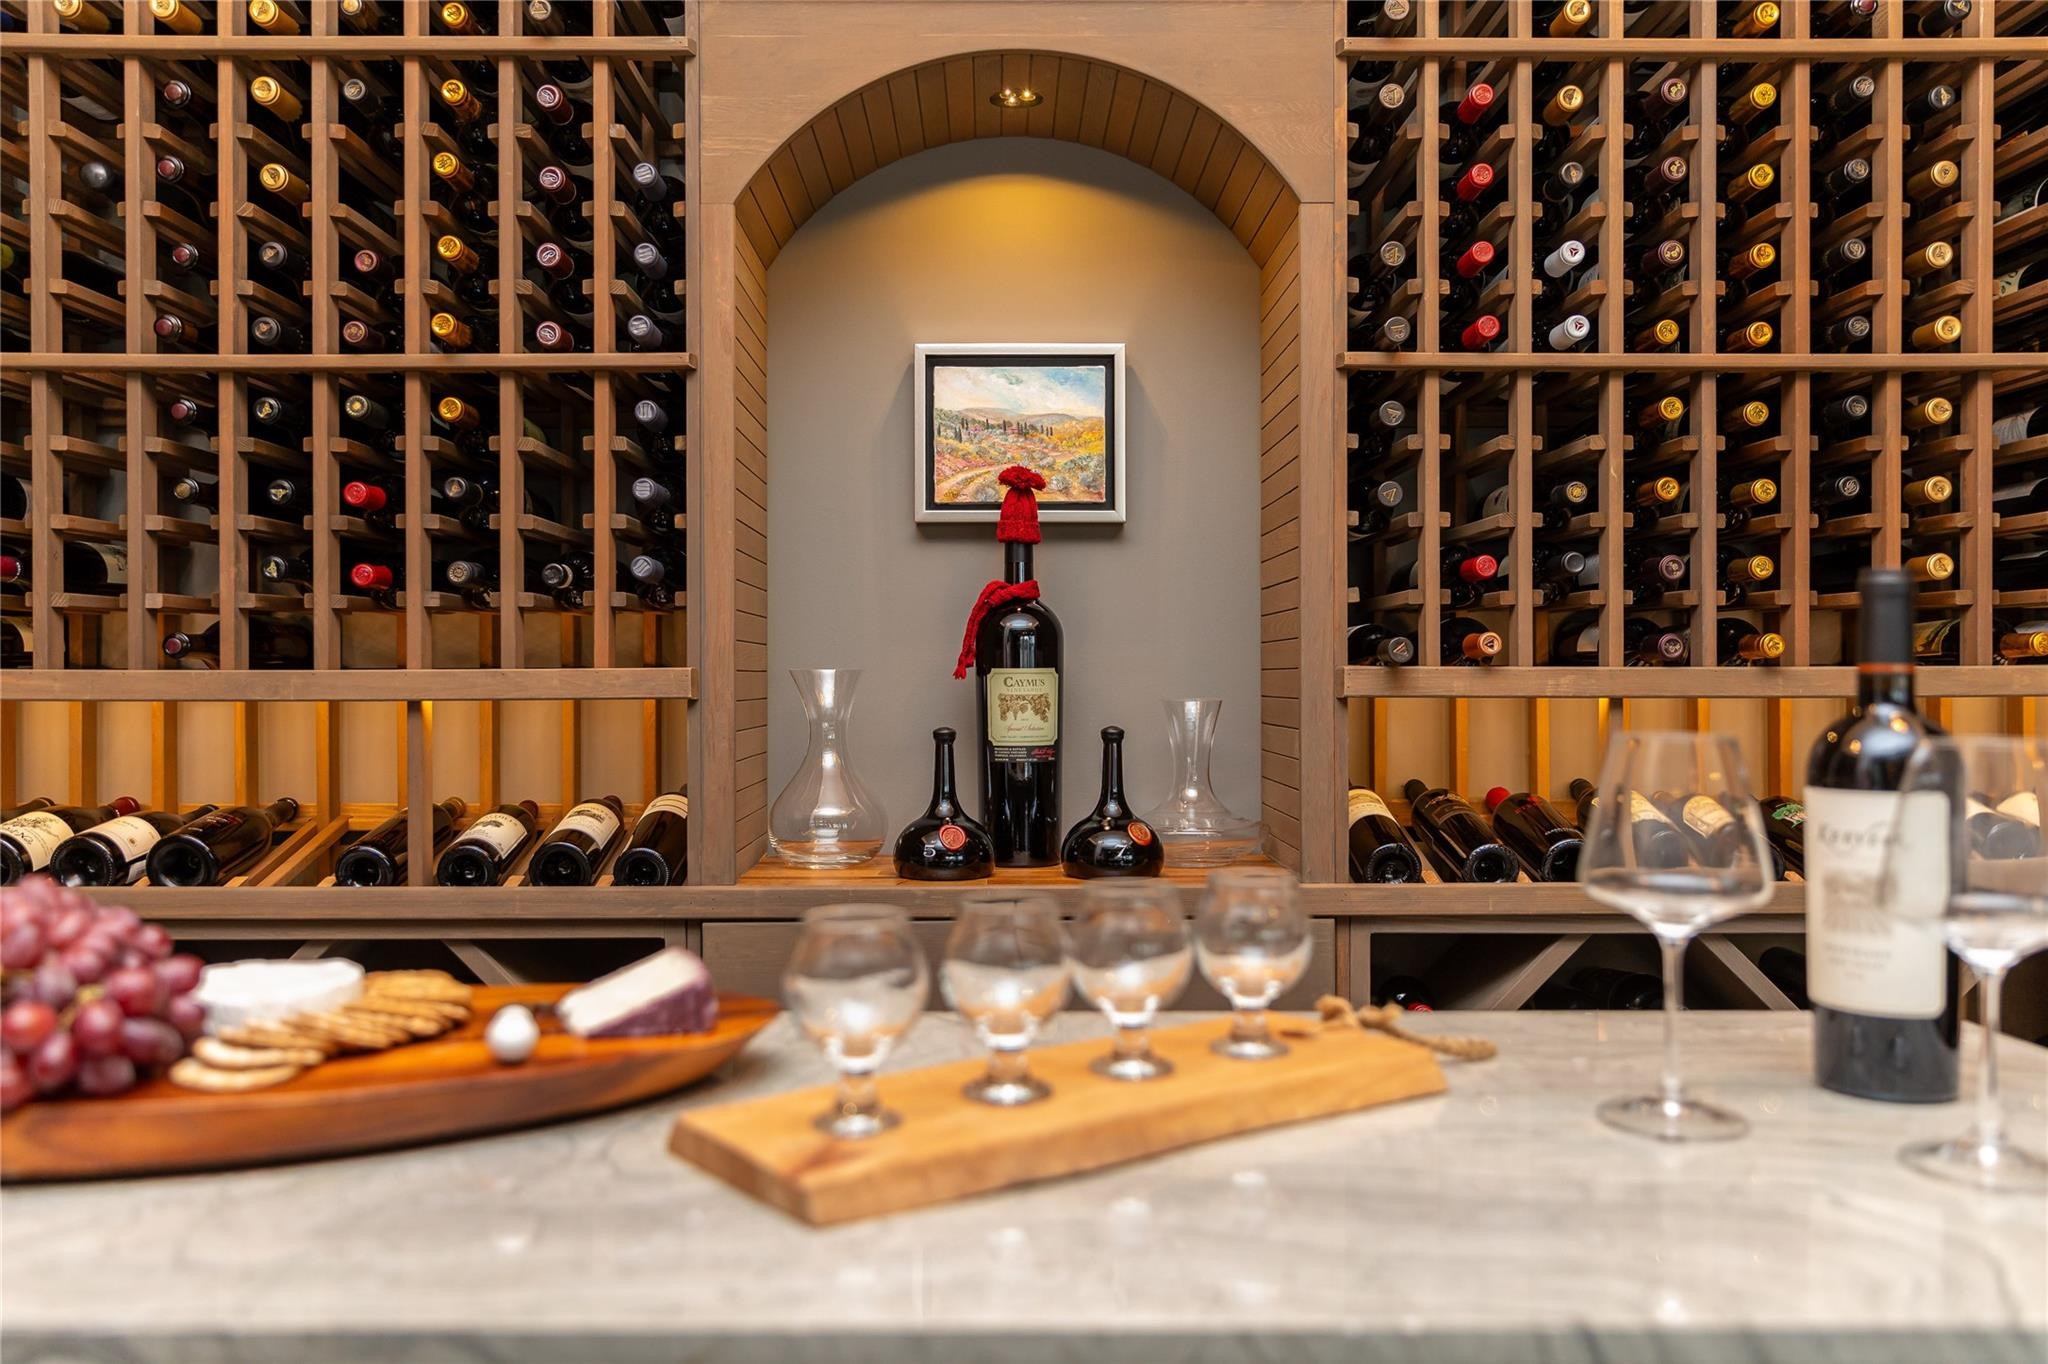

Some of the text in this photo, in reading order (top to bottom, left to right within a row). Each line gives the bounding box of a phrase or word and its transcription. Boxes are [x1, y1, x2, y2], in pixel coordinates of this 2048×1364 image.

[1003, 676, 1046, 688] CAYMUS
[923, 844, 936, 858] 5
[1115, 843, 1128, 859] 7
